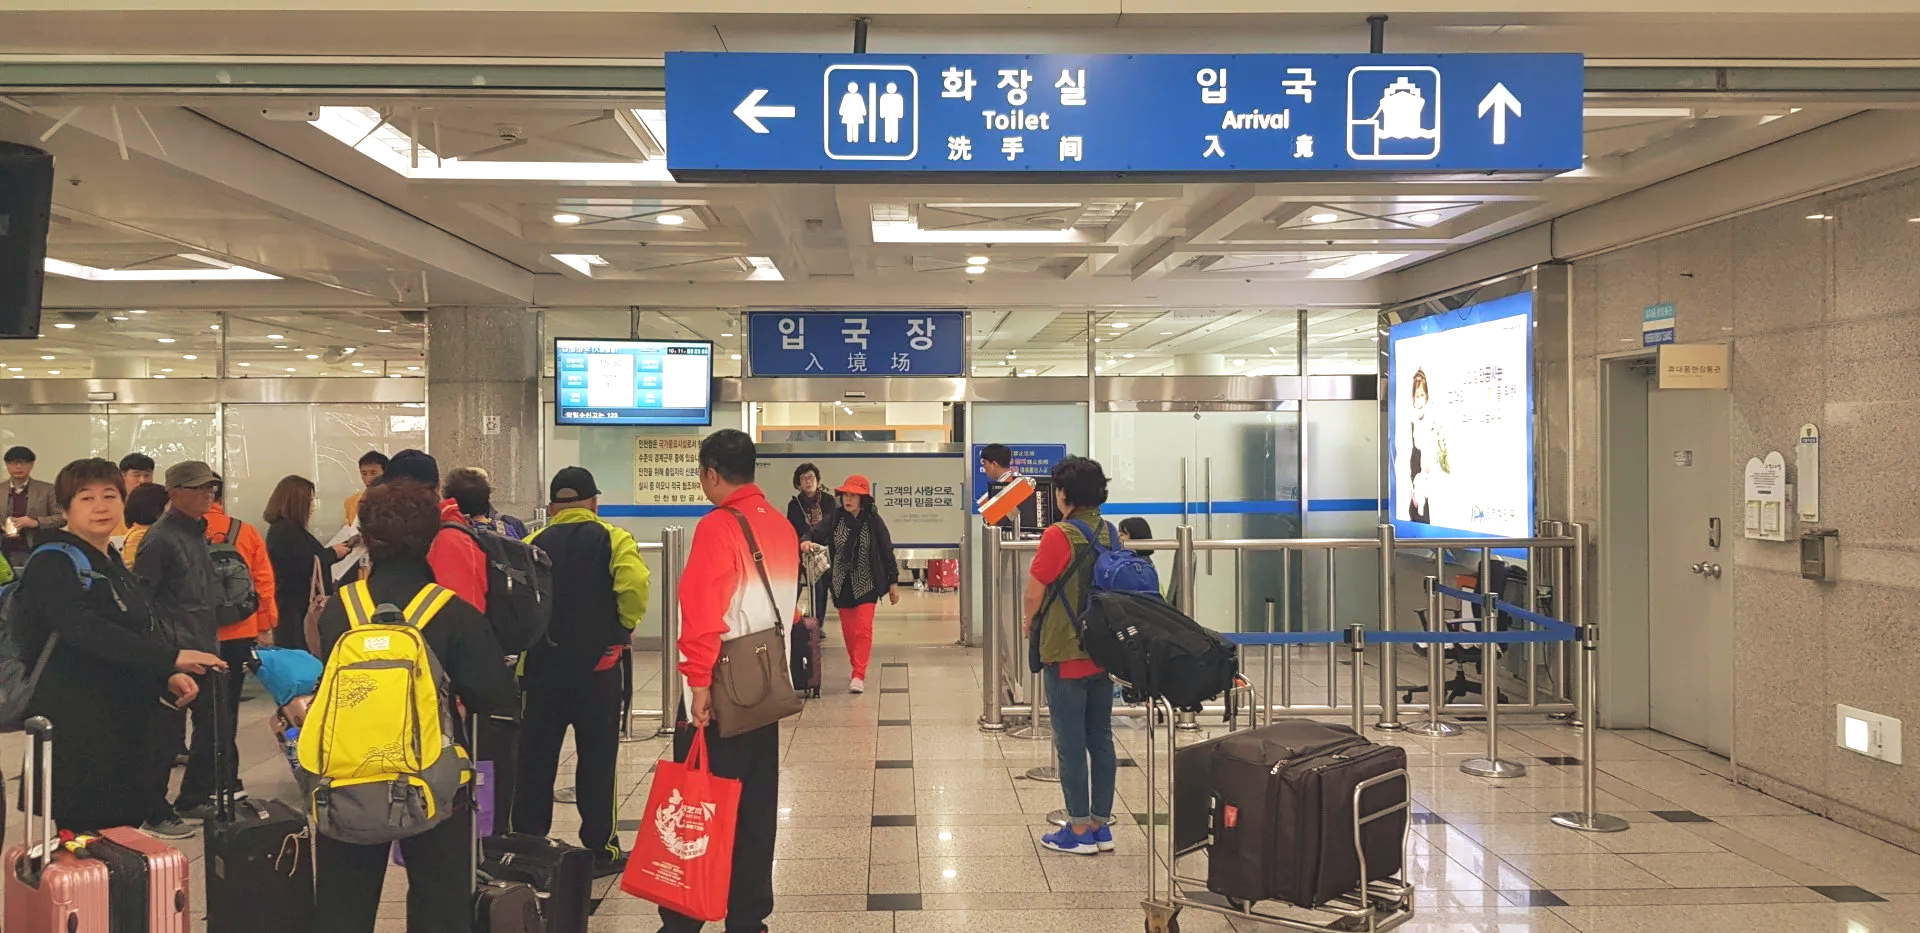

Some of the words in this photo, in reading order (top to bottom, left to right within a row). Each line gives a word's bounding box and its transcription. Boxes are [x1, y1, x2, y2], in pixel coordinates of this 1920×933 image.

[941, 66, 1087, 106] 화장실
[981, 109, 1050, 130] Toilet
[1221, 108, 1290, 130] Arrival
[947, 135, 1083, 162] 洗手间
[778, 317, 936, 351] 입국장
[804, 351, 911, 373] 入境场
[685, 453, 700, 463] 있습니
[884, 486, 912, 496] 고객의
[914, 486, 955, 496] 사랑으로,
[884, 497, 912, 507] 고객의
[914, 497, 953, 507] 믿음으로
